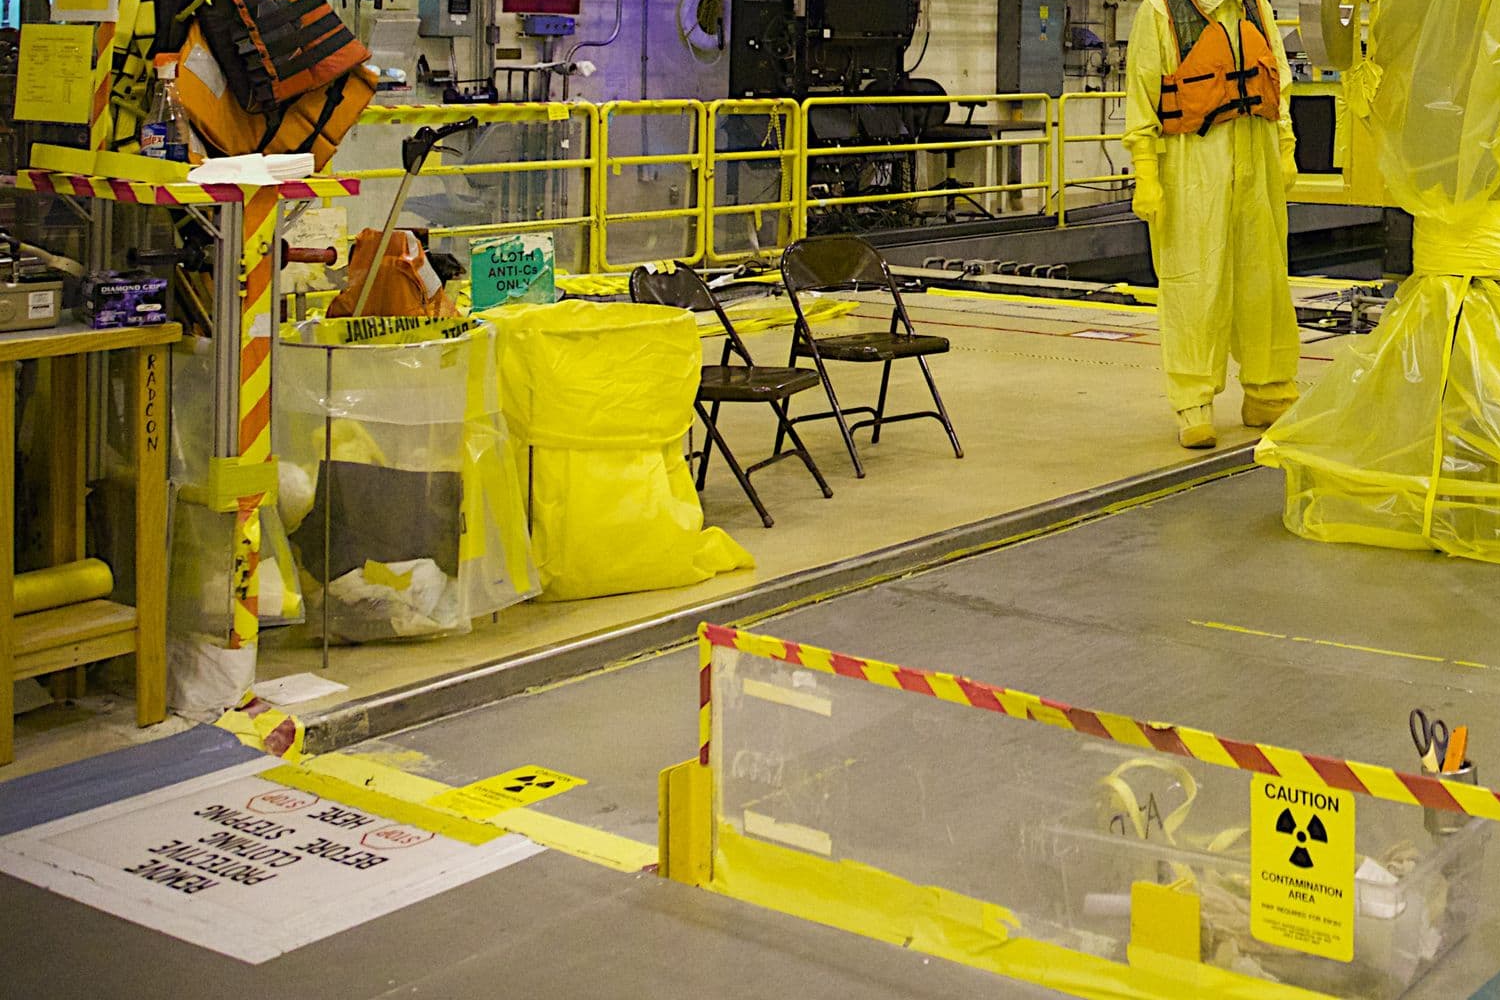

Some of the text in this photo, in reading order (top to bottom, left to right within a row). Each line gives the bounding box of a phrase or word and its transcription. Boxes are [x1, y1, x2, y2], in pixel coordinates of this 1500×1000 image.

[488, 264, 538, 278] ANTI-Cs
[490, 250, 534, 264] CLOTH
[145, 353, 158, 452] RADCON
[261, 793, 305, 808] STOP
[1264, 783, 1339, 812] CAUTION
[307, 806, 376, 829] HERE
[194, 805, 389, 870] BEFORE STEPPING
[198, 832, 302, 868] CLOTHING
[376, 829, 421, 844] STOP
[124, 858, 220, 894] REMOVE
[148, 840, 278, 886] PROTECTIVE
[1261, 871, 1343, 899] CONTAMINATION
[1288, 890, 1316, 904] AREA
